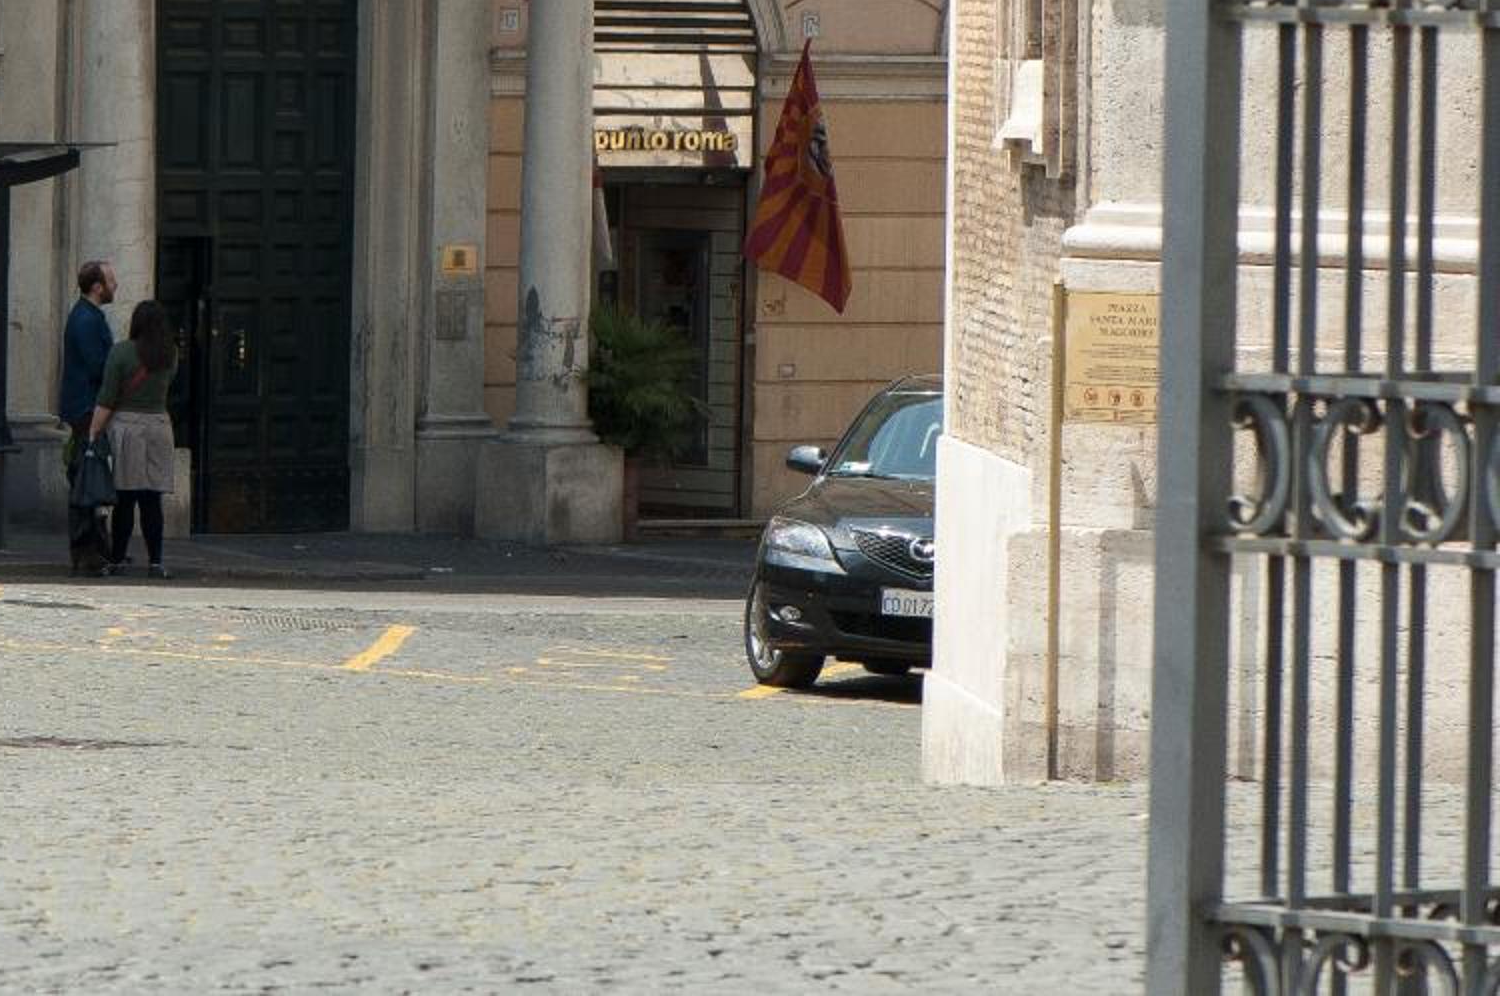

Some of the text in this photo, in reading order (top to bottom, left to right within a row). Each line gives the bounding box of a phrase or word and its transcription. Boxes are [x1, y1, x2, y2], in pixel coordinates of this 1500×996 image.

[595, 129, 738, 153] punto roma
[1127, 316, 1157, 327] MARI
